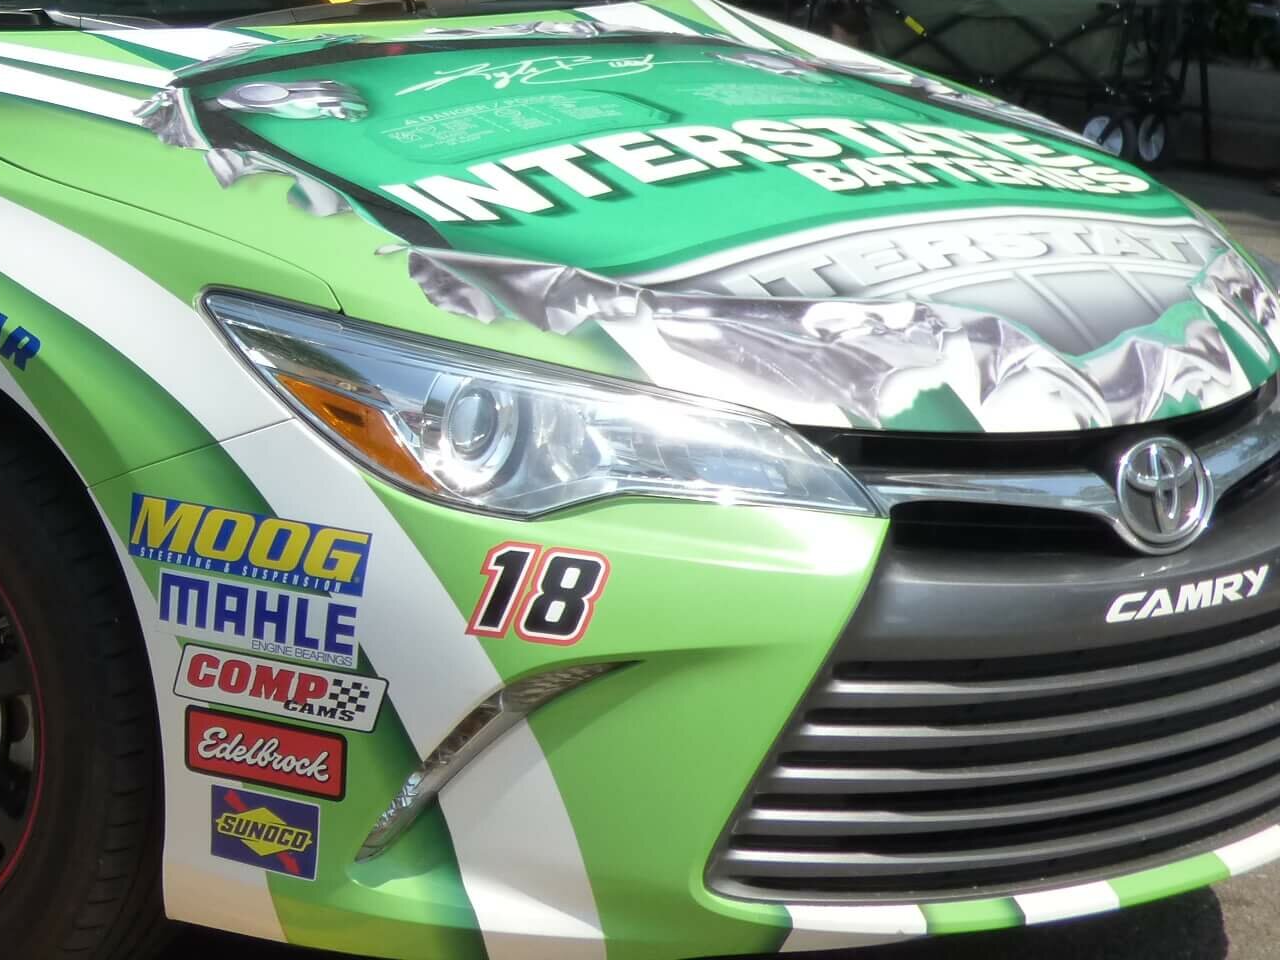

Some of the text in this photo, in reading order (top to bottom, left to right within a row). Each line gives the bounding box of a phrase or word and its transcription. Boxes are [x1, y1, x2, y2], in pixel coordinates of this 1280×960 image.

[378, 117, 1094, 223] INTERSTATE
[787, 155, 1151, 193] BATTERIES
[131, 496, 369, 583] MOOG
[140, 546, 343, 594] STEERING & SUSPENSION
[471, 545, 606, 642] 18
[1105, 564, 1270, 624] CAMRY
[159, 572, 358, 657] MAHLE
[187, 653, 330, 704] COMP
[251, 639, 353, 668] ENGINE BEARINGS
[283, 699, 356, 723] CAMS
[197, 727, 330, 783] Edelbrock
[221, 815, 312, 851] SUNOCO
